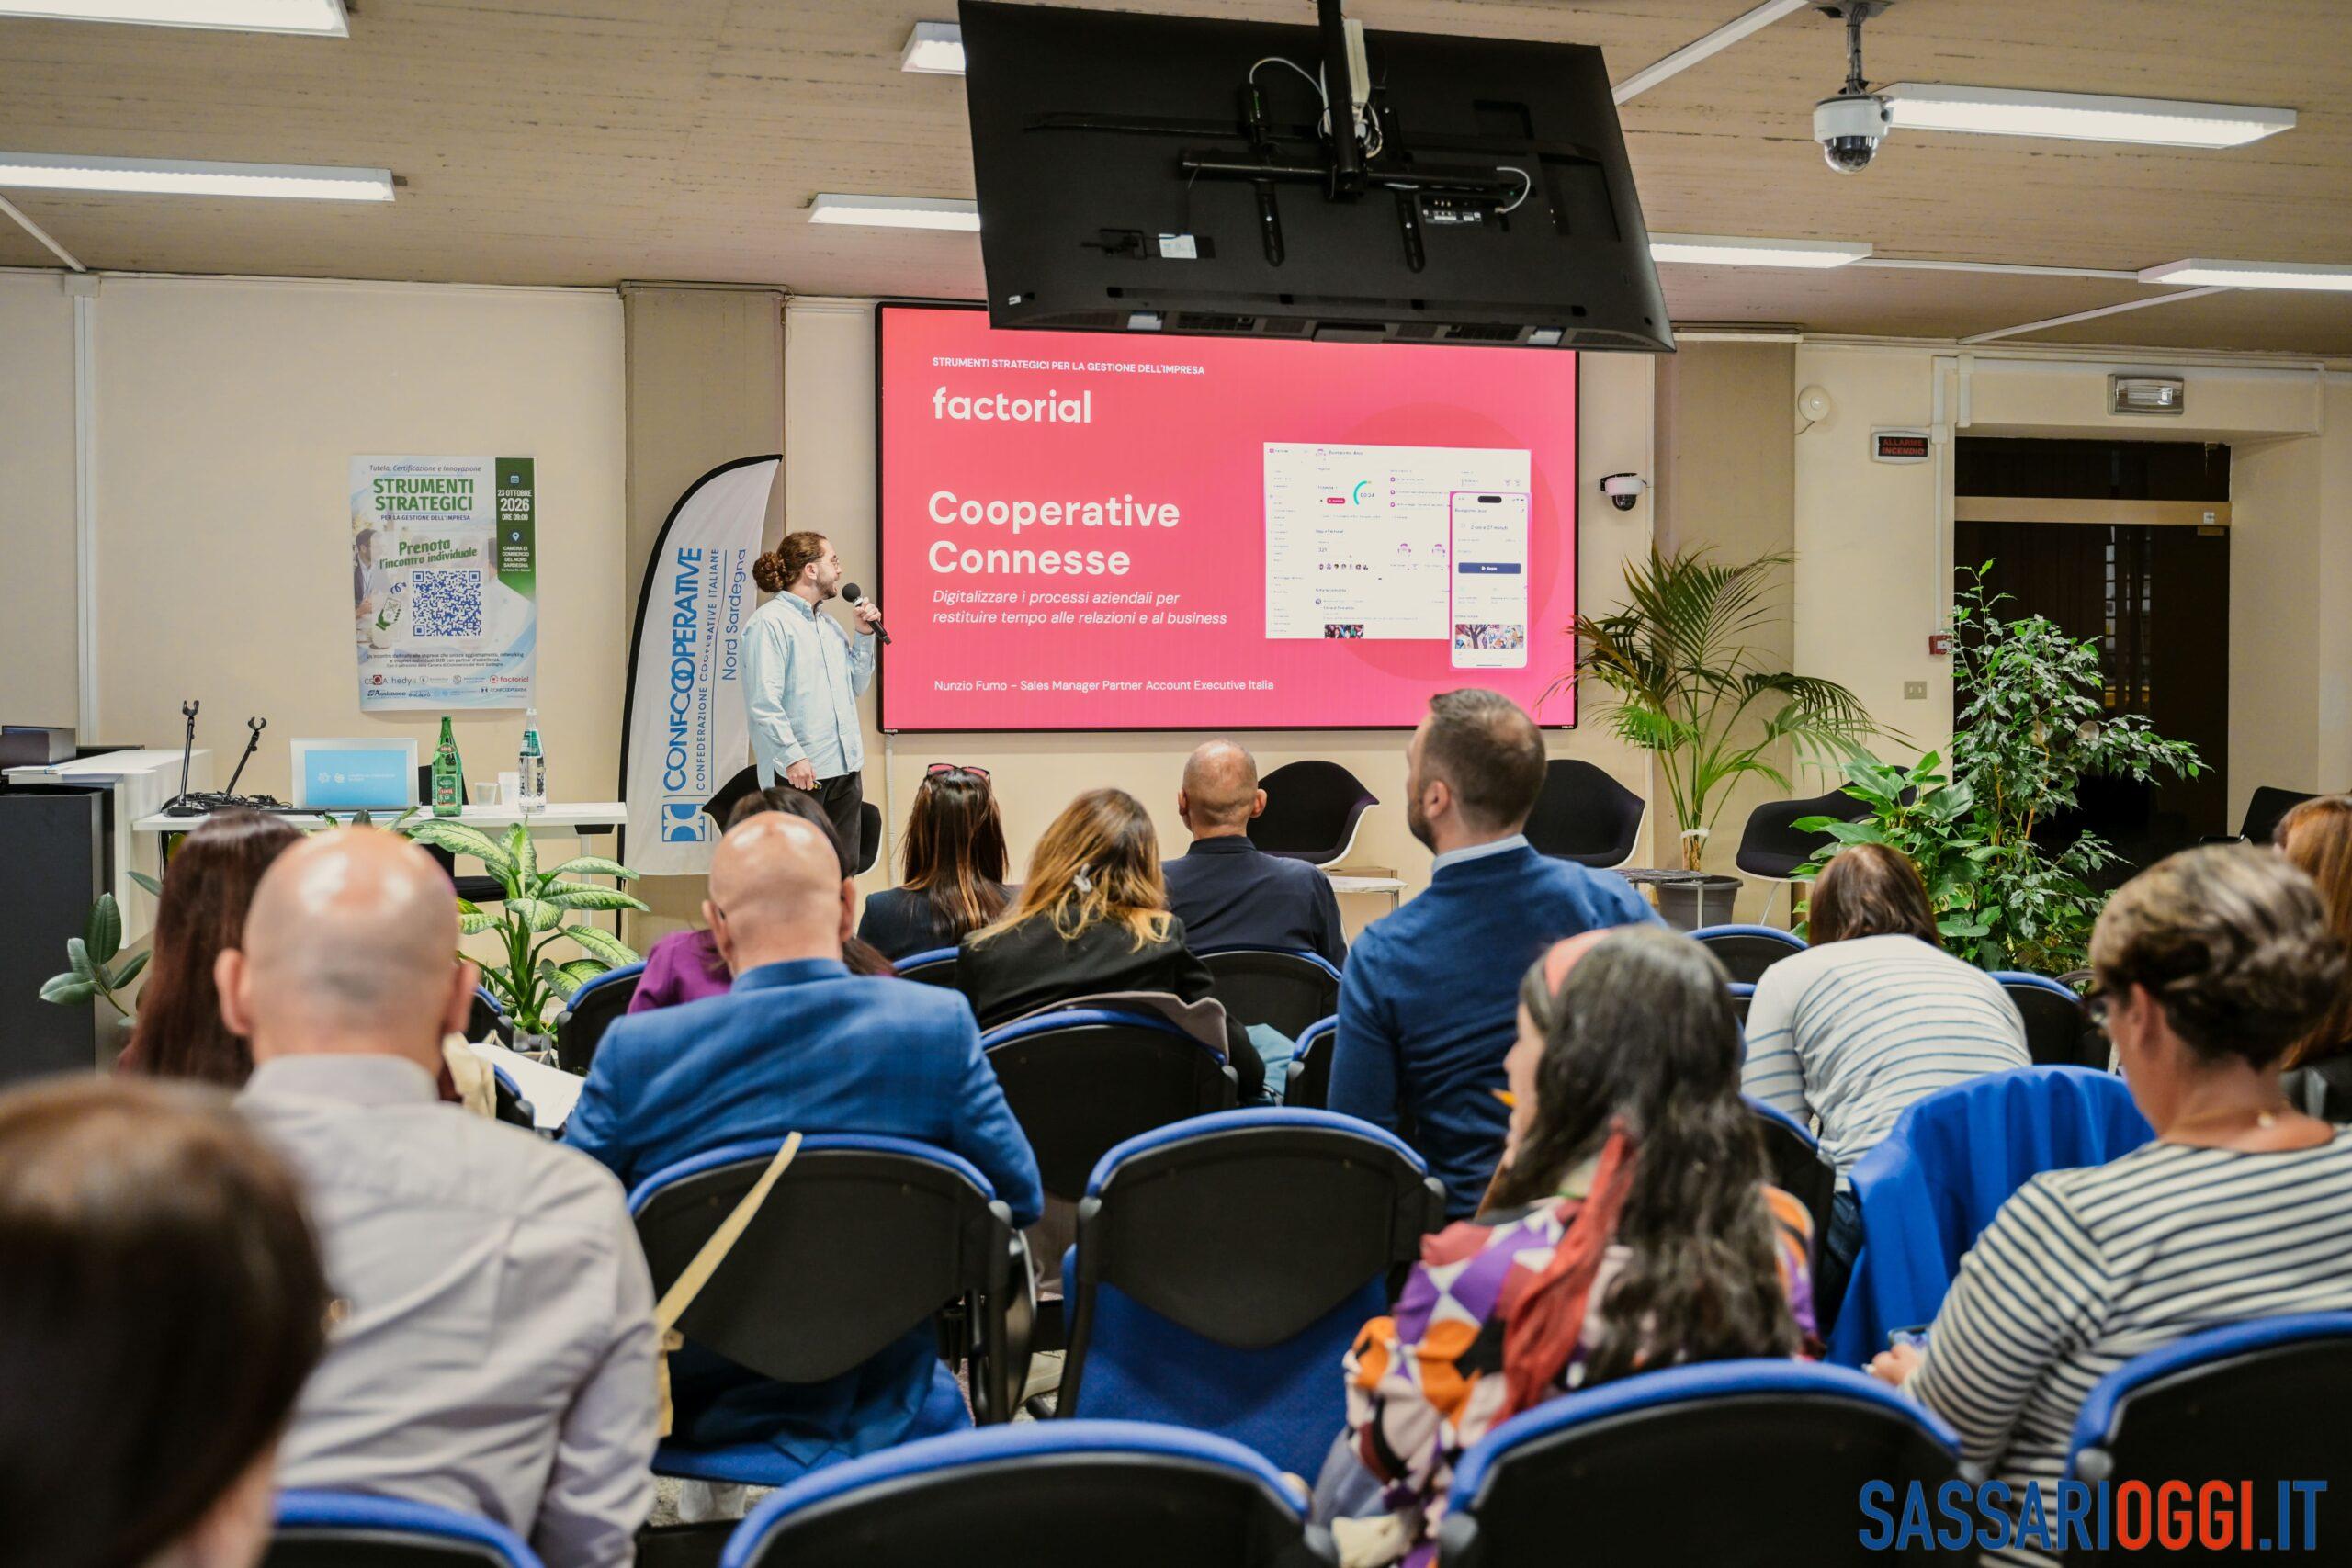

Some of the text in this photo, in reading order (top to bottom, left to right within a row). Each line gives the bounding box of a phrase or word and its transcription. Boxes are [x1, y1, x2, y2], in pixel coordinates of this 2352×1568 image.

[933, 357, 1205, 375] STRUMENTI STRATEGICI PER LA GESTIONE DELL'IMPRESA
[933, 387, 1091, 423] factorial
[1883, 438, 1924, 446] ALLARME
[392, 465, 435, 473] Certificazione
[373, 479, 474, 494] STRUMENTI
[375, 496, 472, 511] STRATEGICI
[500, 498, 530, 512] 2026
[928, 491, 1180, 535] Cooperative
[399, 539, 451, 556] Prenota
[379, 547, 478, 570] l'incontro individuale
[928, 540, 1130, 576] Connesse
[933, 590, 1180, 606] Digitalizzare i processi aziendali per
[722, 549, 746, 681] Nord Sardegna
[933, 610, 1227, 626] restituire tempo alle relazioni e al business
[662, 547, 702, 791] CONFCOOPERATIVE
[695, 548, 719, 791] CONFEDERAZIONE COOPERATIVE ITALIANE
[934, 681, 973, 691] Nunzio
[976, 681, 1007, 691] Fumo
[1021, 681, 1049, 691] Sales
[1053, 681, 1100, 693] Manager
[1102, 681, 1143, 691] Partner
[1146, 681, 1191, 691] Account
[1194, 681, 1246, 691] Executive
[1249, 681, 1274, 691] Italia
